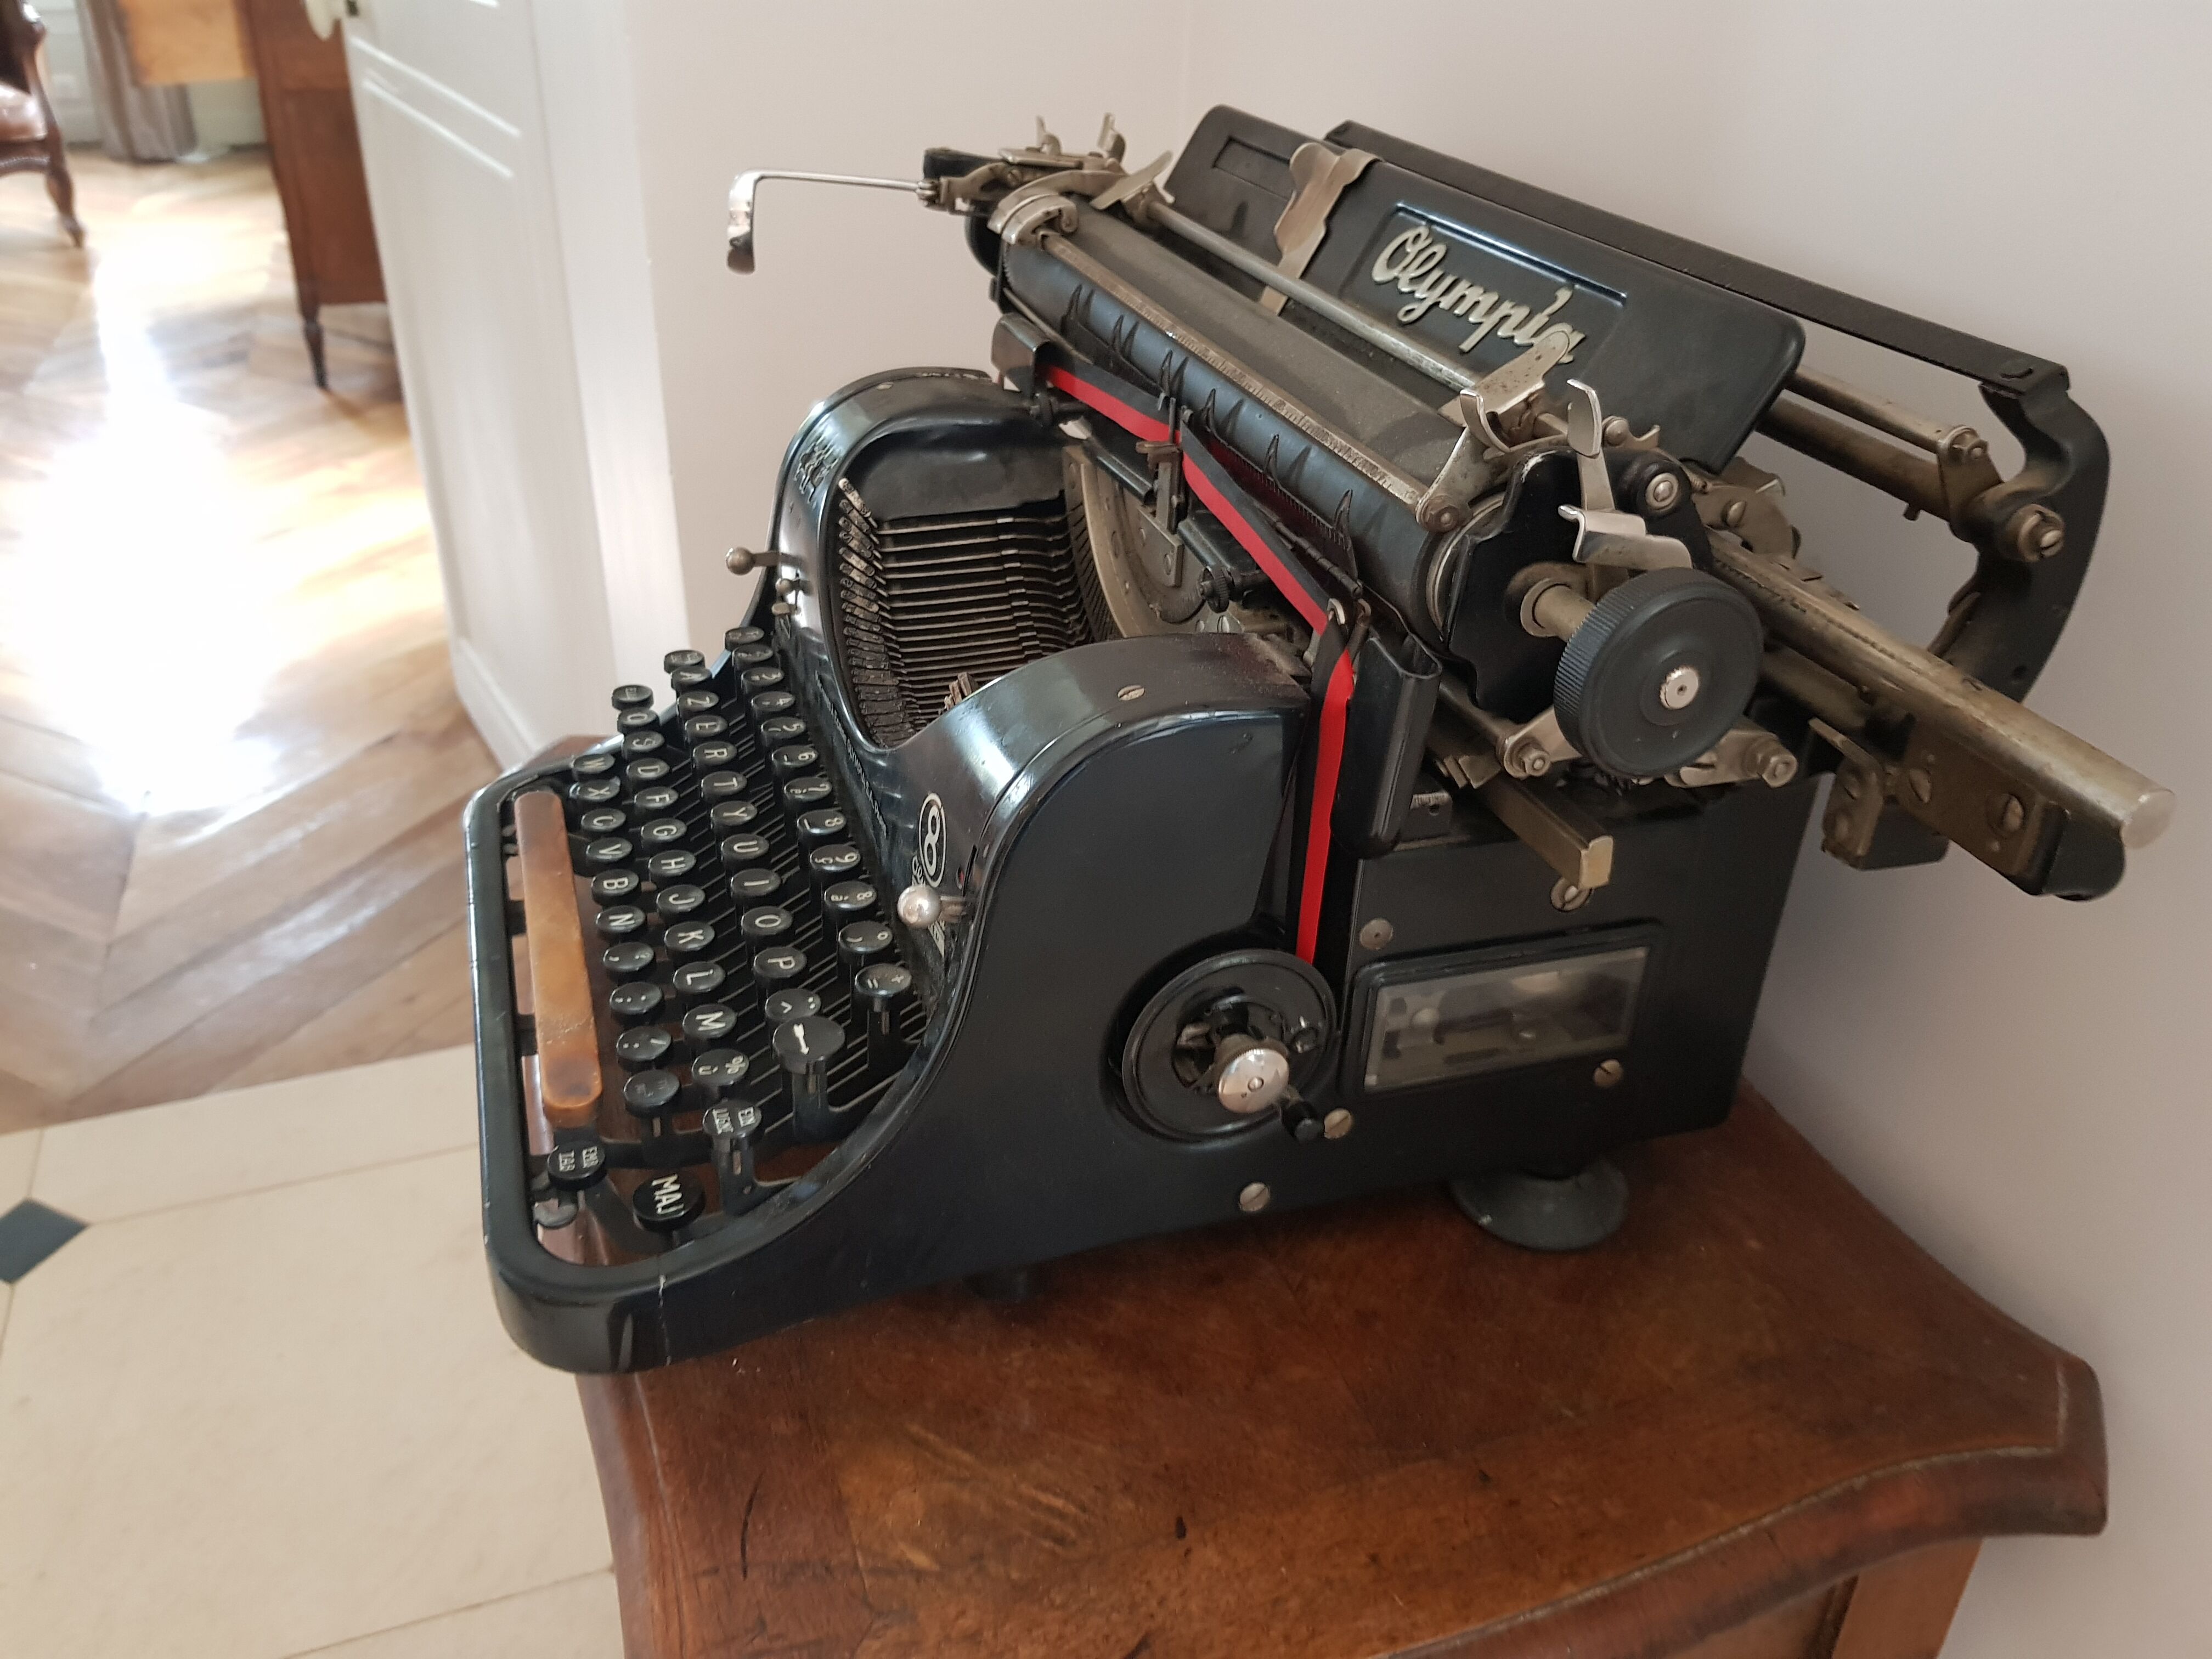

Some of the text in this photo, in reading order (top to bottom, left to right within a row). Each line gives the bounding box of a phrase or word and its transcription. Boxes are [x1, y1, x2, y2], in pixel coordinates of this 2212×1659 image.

[687, 696, 710, 707] Z
[696, 721, 717, 731] E
[782, 723, 804, 732] 5
[633, 738, 656, 747] S
[704, 748, 728, 760] R
[583, 758, 606, 768] W
[637, 766, 661, 776] D
[714, 777, 738, 787] T
[808, 783, 830, 792] 7
[588, 786, 611, 796] X
[646, 793, 670, 803] F
[723, 806, 748, 817] Y
[593, 815, 614, 827] C
[825, 816, 845, 828] 8
[653, 825, 678, 836] G
[599, 843, 623, 855] V
[733, 840, 760, 853] U
[661, 857, 686, 870] H
[835, 851, 858, 864] 9
[603, 877, 629, 890] B
[669, 893, 696, 905] J
[609, 913, 635, 927] N
[755, 914, 782, 928] O
[678, 929, 705, 944] K
[768, 956, 796, 970] P
[686, 968, 714, 986] L
[695, 1010, 727, 1031] M
[651, 1172, 685, 1216] MAJ
